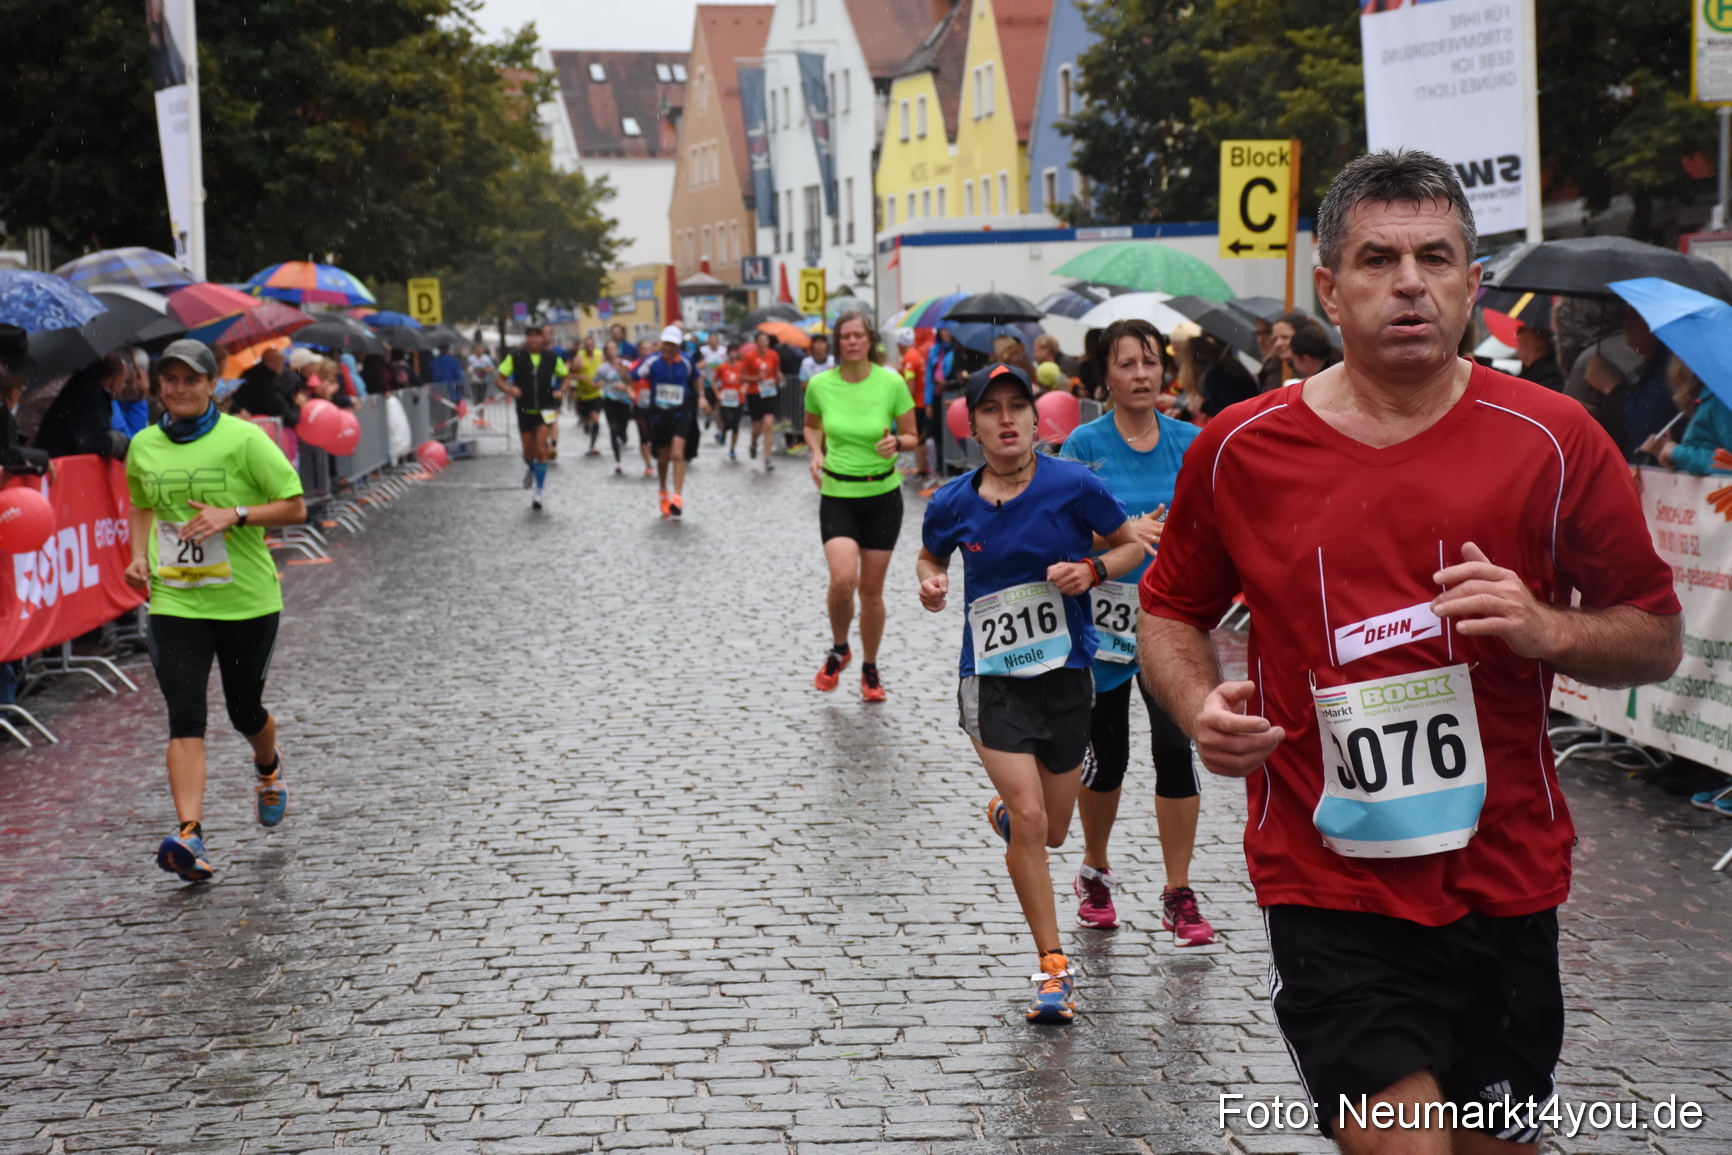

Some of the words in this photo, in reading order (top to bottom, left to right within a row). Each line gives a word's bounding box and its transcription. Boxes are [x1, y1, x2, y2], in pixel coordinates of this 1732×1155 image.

[1231, 146, 1290, 167] Block
[1239, 176, 1278, 233] C
[806, 281, 820, 303] D
[417, 293, 433, 315] D
[981, 601, 1058, 652] 2316
[1364, 618, 1411, 645] DEHN
[1004, 648, 1044, 669] Nicole
[1360, 674, 1455, 709] BOCK
[1363, 706, 1391, 718] inspired
[1393, 704, 1401, 713] by
[1403, 701, 1424, 711] smart
[1425, 695, 1458, 707] concepts
